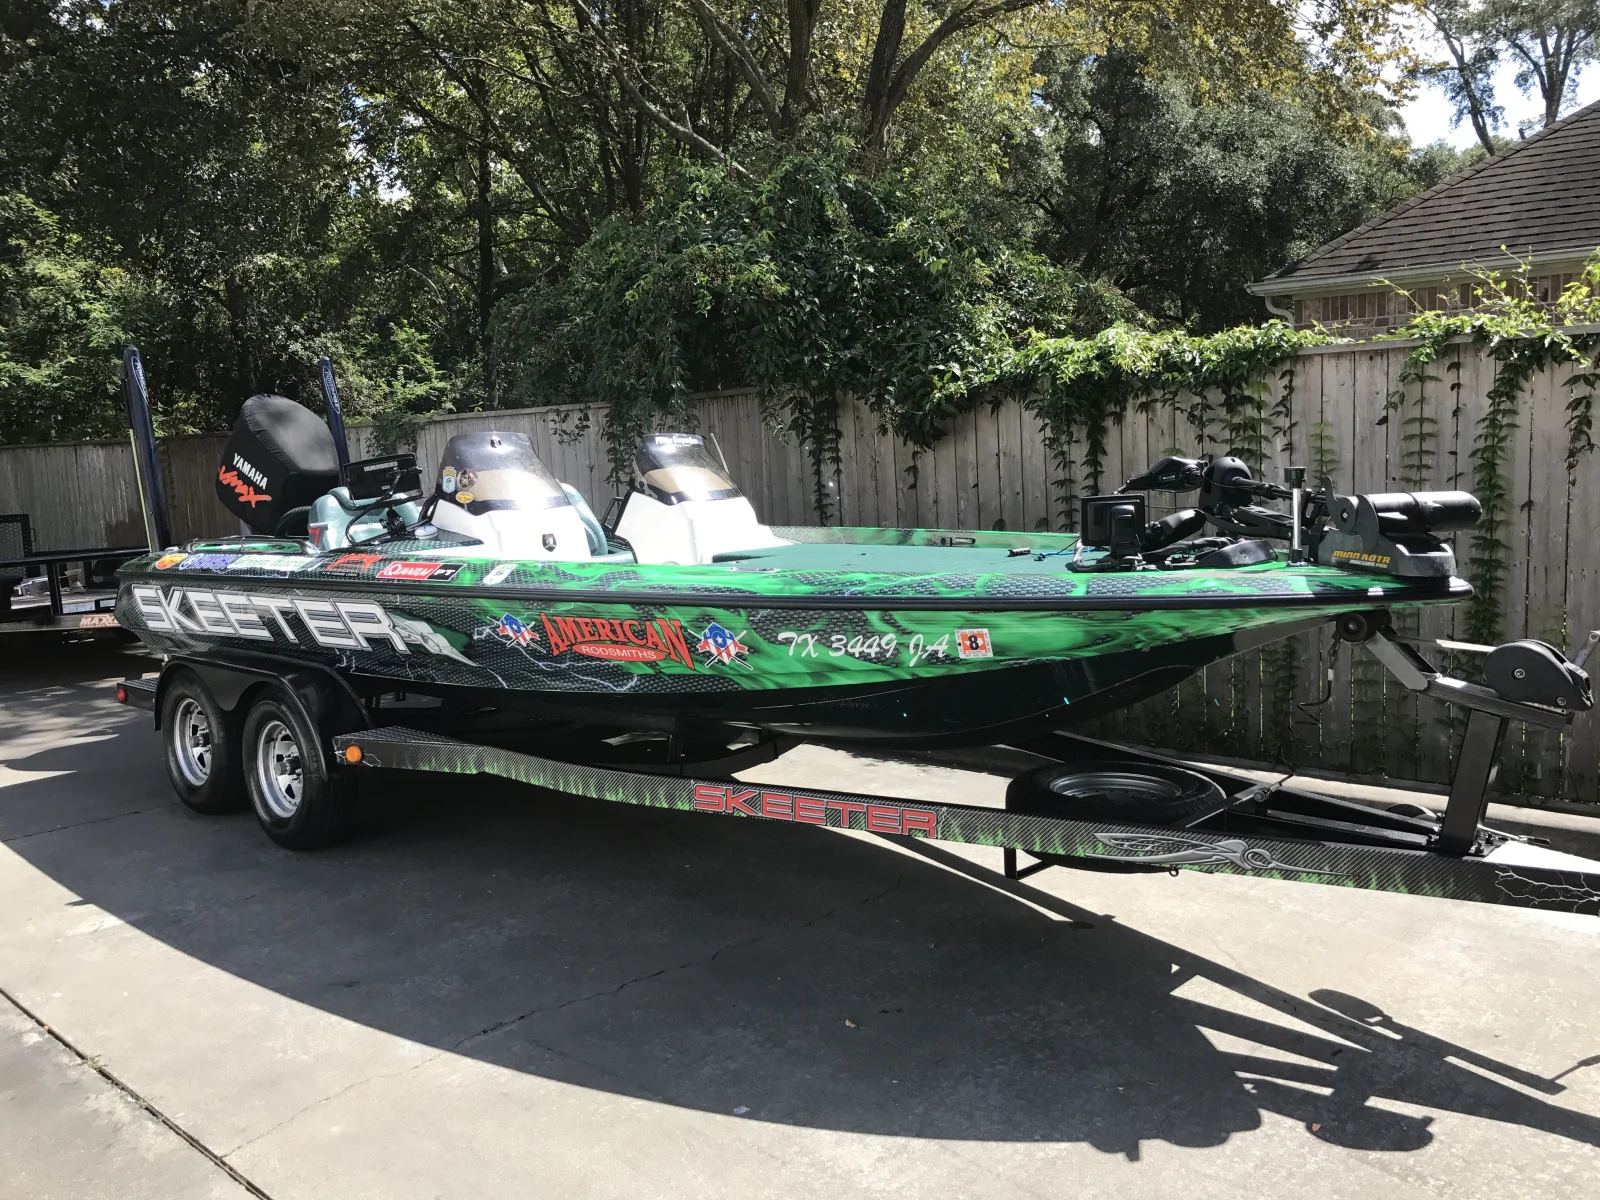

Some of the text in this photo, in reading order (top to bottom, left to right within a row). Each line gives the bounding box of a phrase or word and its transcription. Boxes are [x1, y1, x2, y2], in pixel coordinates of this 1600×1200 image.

[233, 452, 268, 490] YAMAHA
[1333, 550, 1391, 564] MINN KOTA
[433, 568, 456, 577] PT
[80, 615, 119, 626] MAXX
[132, 584, 411, 655] SKEETER
[539, 612, 696, 670] AMERICAN
[581, 645, 657, 660] RODSMITHS
[777, 631, 950, 668] TX 3449 JA
[967, 635, 980, 651] 8
[693, 783, 938, 839] SKEETER
